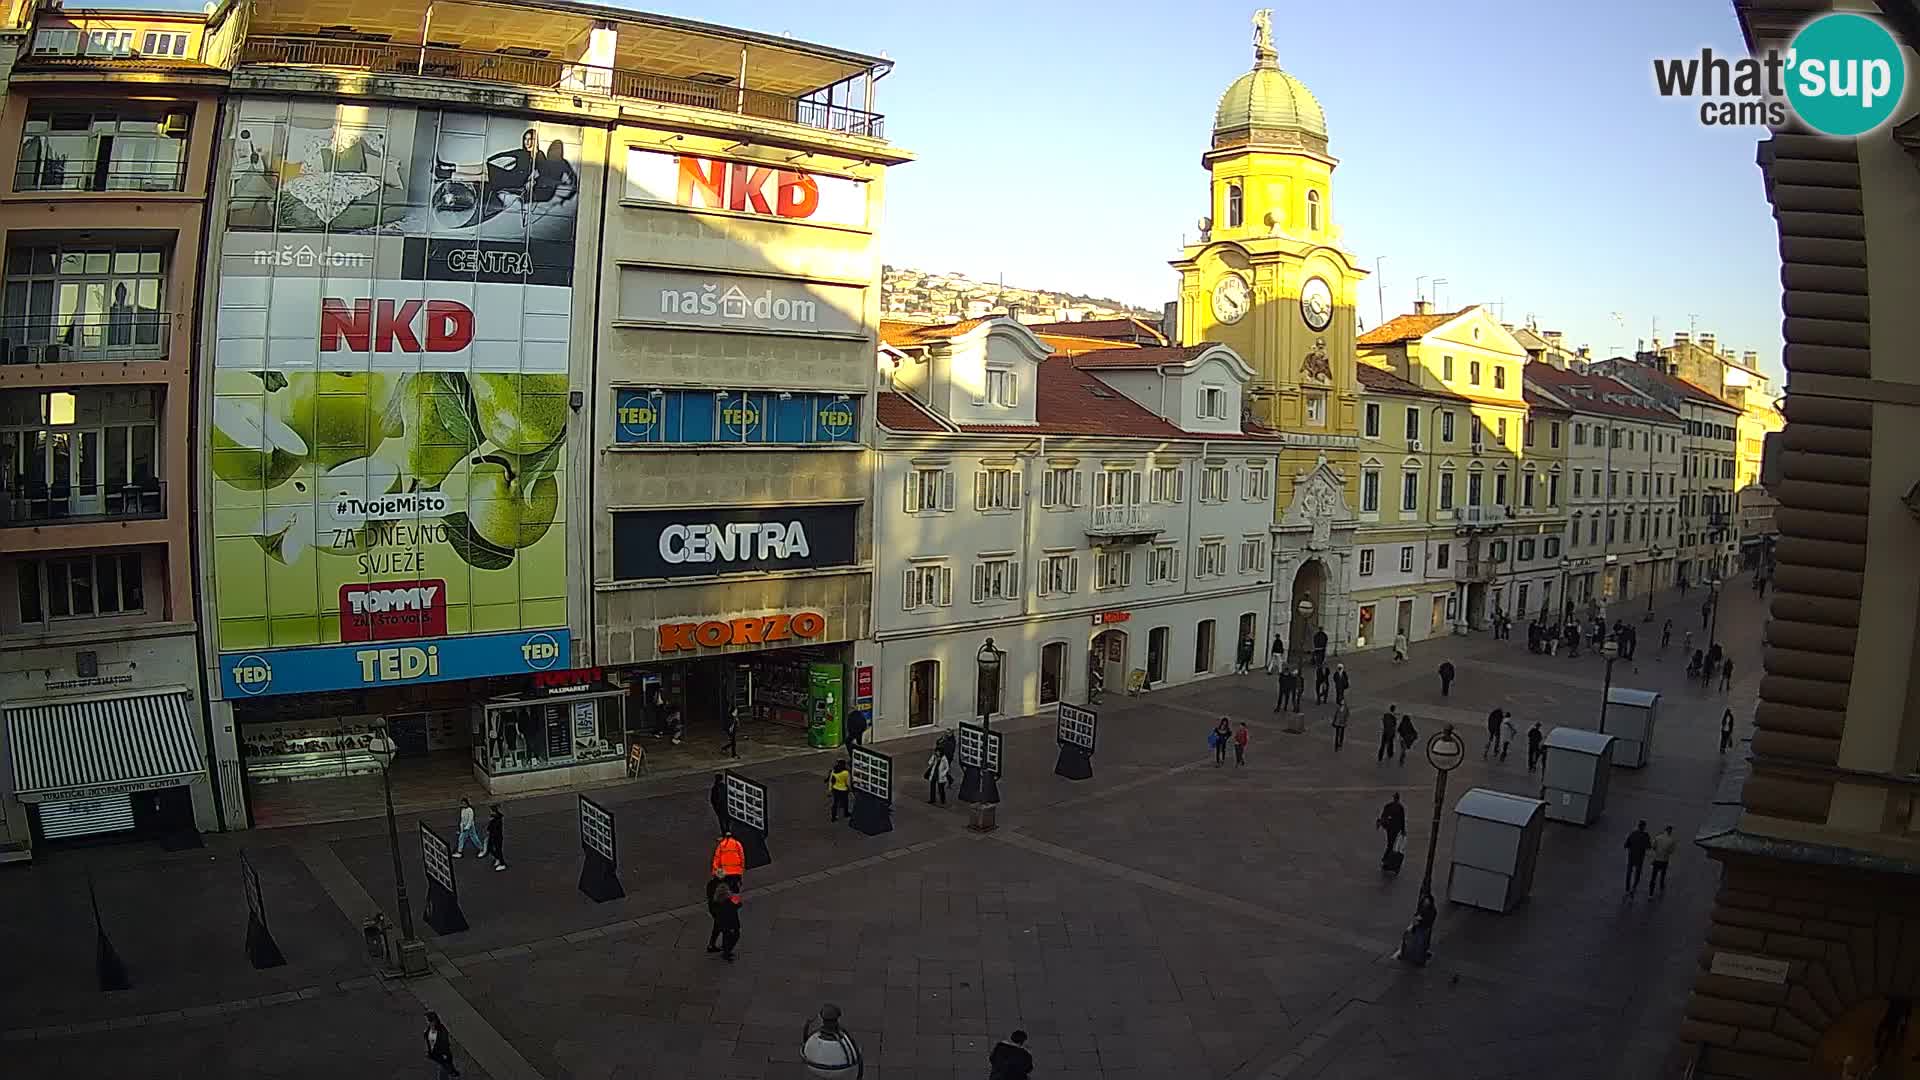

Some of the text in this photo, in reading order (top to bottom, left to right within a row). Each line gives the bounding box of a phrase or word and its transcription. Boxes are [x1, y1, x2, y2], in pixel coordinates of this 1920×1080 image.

[677, 155, 820, 218] NKD
[253, 244, 364, 268] naš dom
[447, 249, 534, 275] CENTRA
[660, 282, 817, 323] naš dom
[320, 296, 477, 354] NKD
[618, 407, 657, 425] TEDi
[723, 407, 759, 426] TEDi
[819, 409, 853, 427] TEDi
[336, 496, 446, 516] #TvojeMisto
[332, 522, 449, 549] ZA DNEVNO
[658, 521, 811, 564] CENTRA
[357, 547, 426, 576] SVJEŽE
[347, 586, 439, 614] TOMMY
[658, 611, 825, 653] KORZO
[356, 645, 439, 683] TEDi
[521, 641, 560, 661] TEDi
[232, 665, 272, 685] TEDi
